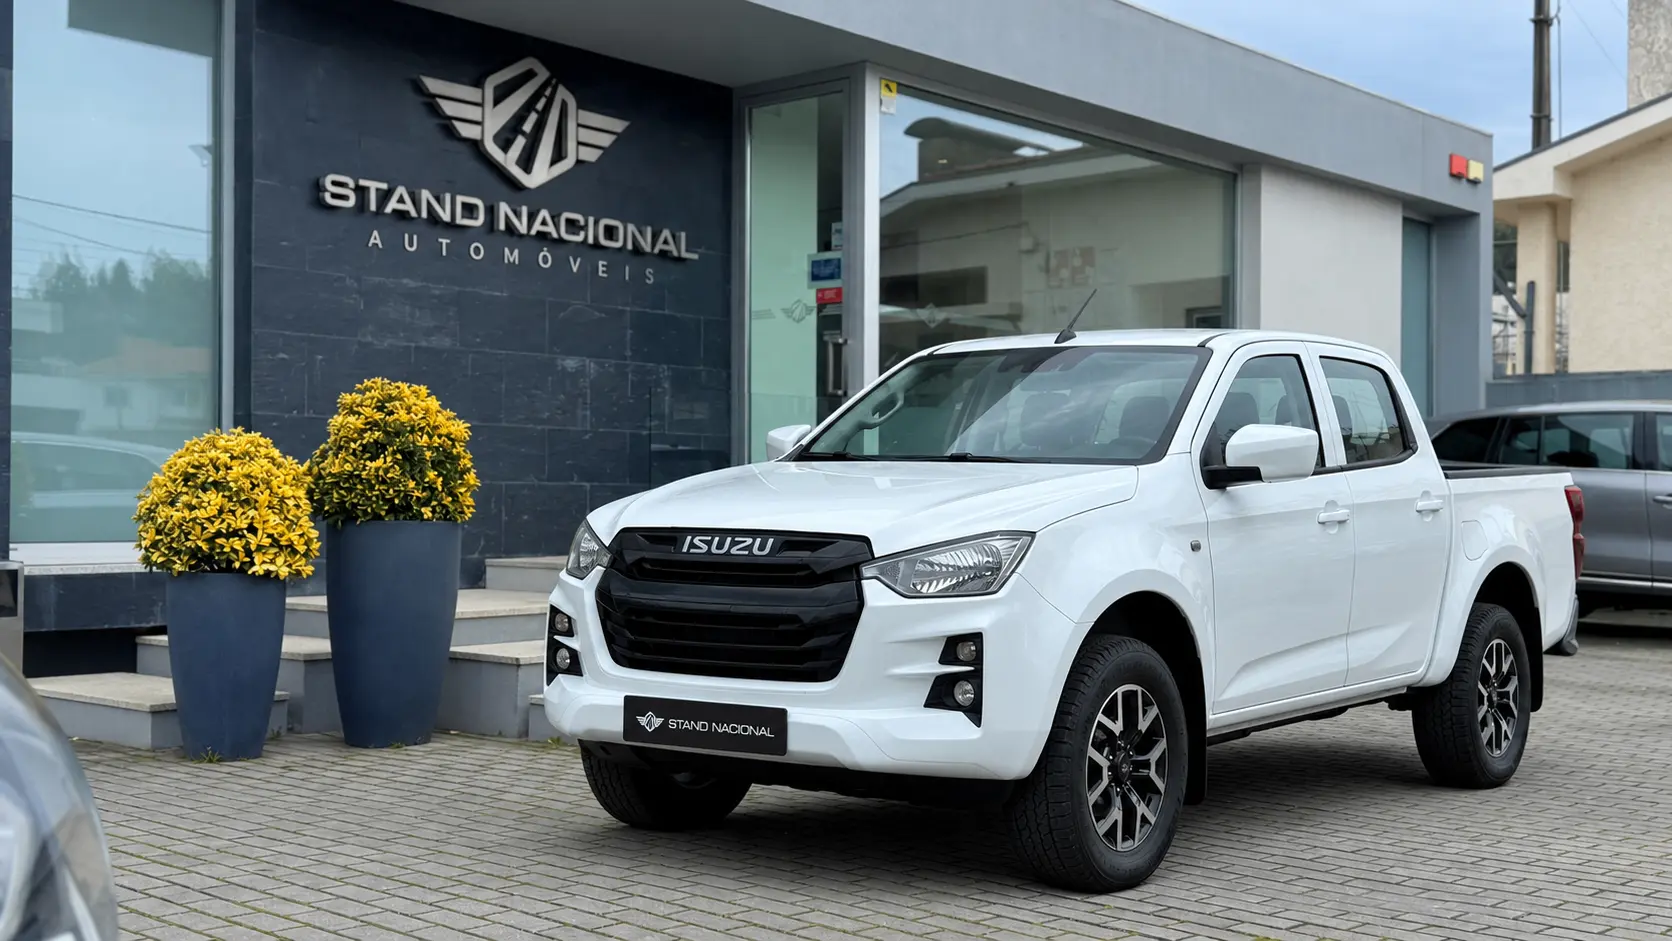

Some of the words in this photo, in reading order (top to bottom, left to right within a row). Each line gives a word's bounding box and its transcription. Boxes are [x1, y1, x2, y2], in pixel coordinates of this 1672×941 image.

[321, 173, 485, 228] STAND
[497, 201, 700, 260] NACIONAL
[367, 229, 656, 285] AUTOMÓVEIS
[681, 535, 775, 556] ISUZU
[668, 718, 709, 732] STAND
[711, 722, 775, 738] NACIONAL
